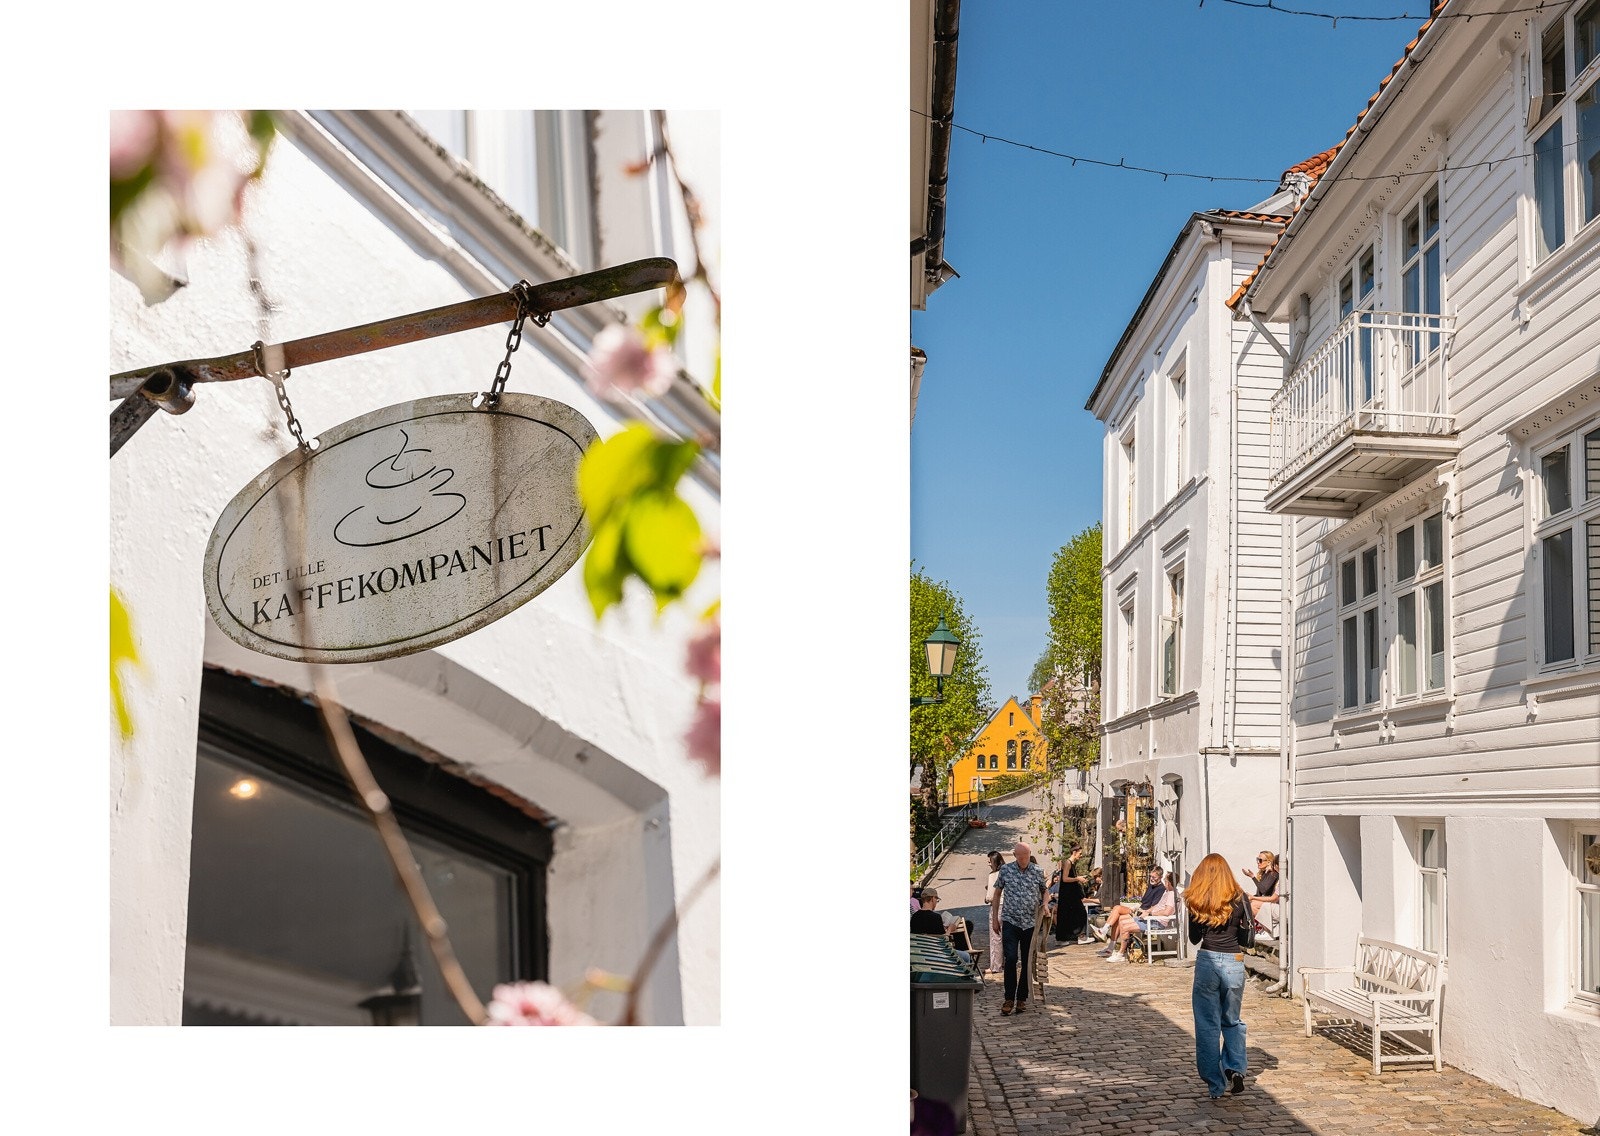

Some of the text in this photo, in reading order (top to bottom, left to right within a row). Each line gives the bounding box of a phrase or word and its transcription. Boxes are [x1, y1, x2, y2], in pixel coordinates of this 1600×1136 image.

[252, 560, 325, 590] DET LILLE
[252, 525, 553, 626] KAFFEKOMPANIET
